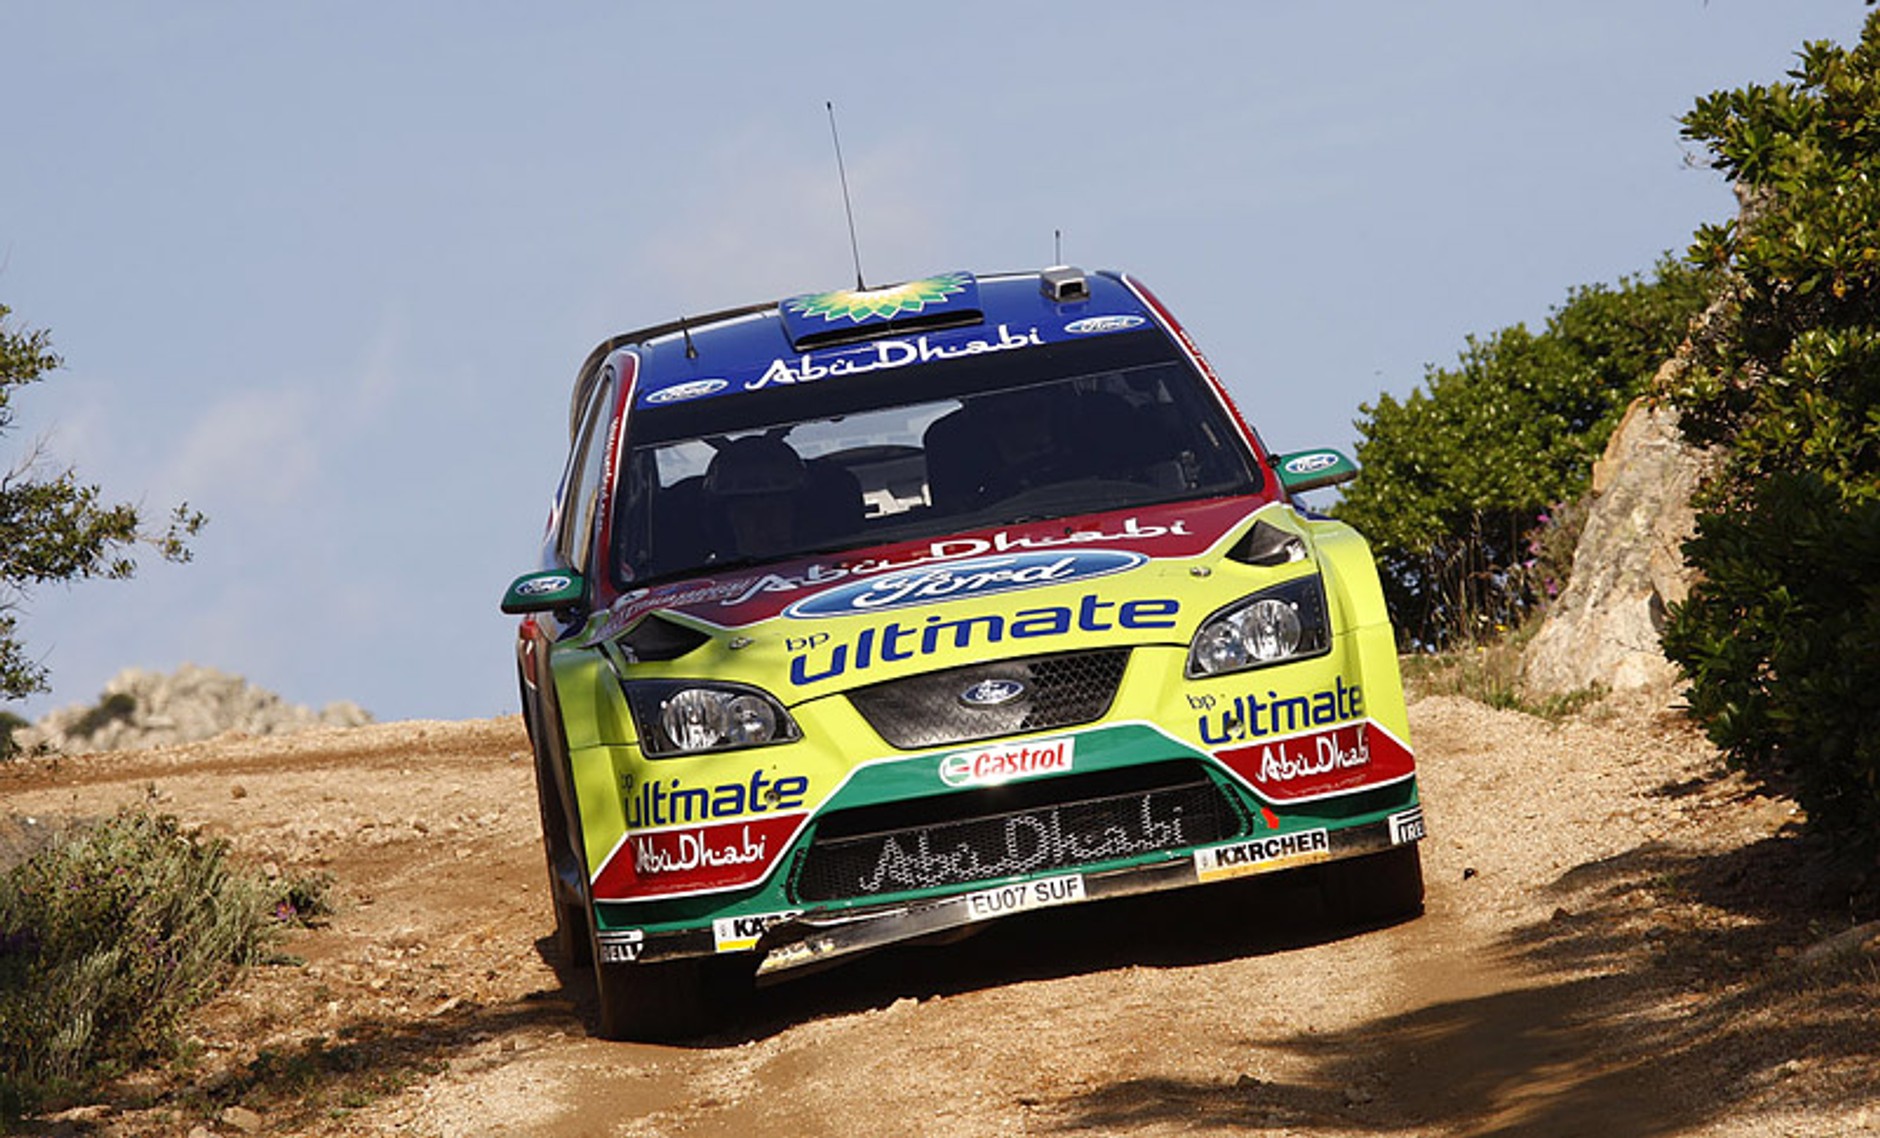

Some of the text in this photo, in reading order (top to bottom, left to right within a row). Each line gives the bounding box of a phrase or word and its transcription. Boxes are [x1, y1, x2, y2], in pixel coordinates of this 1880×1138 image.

[853, 556, 1076, 607] Ford
[785, 632, 830, 653] bp
[789, 594, 1180, 686] ultimate
[1186, 693, 1216, 710] bp
[1199, 676, 1364, 745] ultimate
[973, 743, 1064, 778] Castrol
[625, 770, 808, 827] ultimate
[1215, 831, 1327, 868] KÄRCHER
[972, 877, 1080, 916] EU07 SUF
